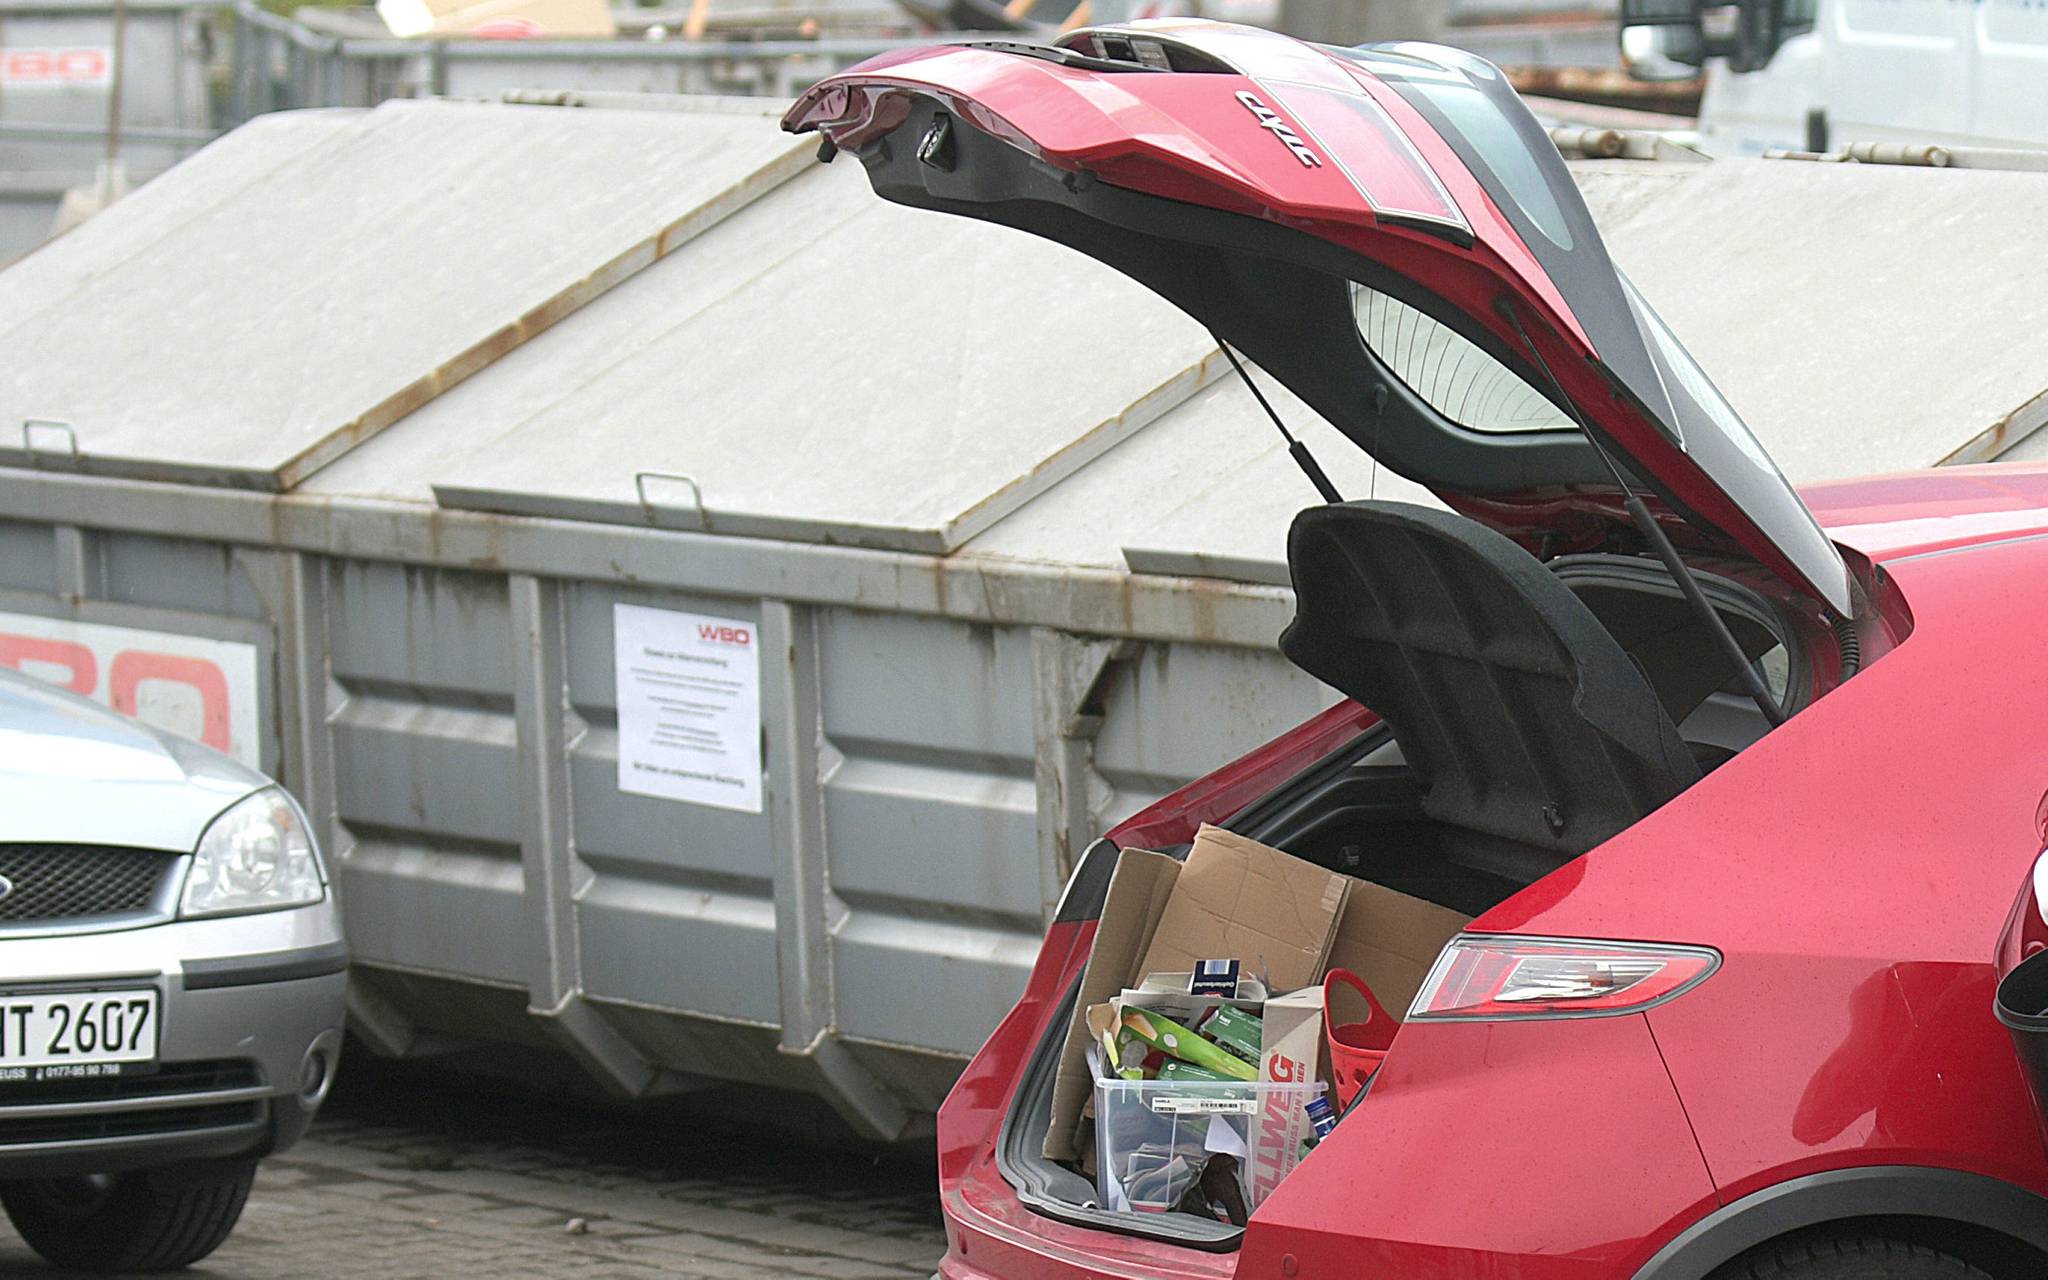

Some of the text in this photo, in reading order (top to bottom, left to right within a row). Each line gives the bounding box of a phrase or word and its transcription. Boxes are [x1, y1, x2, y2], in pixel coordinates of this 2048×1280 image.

[698, 624, 750, 645] WBO
[0, 999, 150, 1057] T 2607
